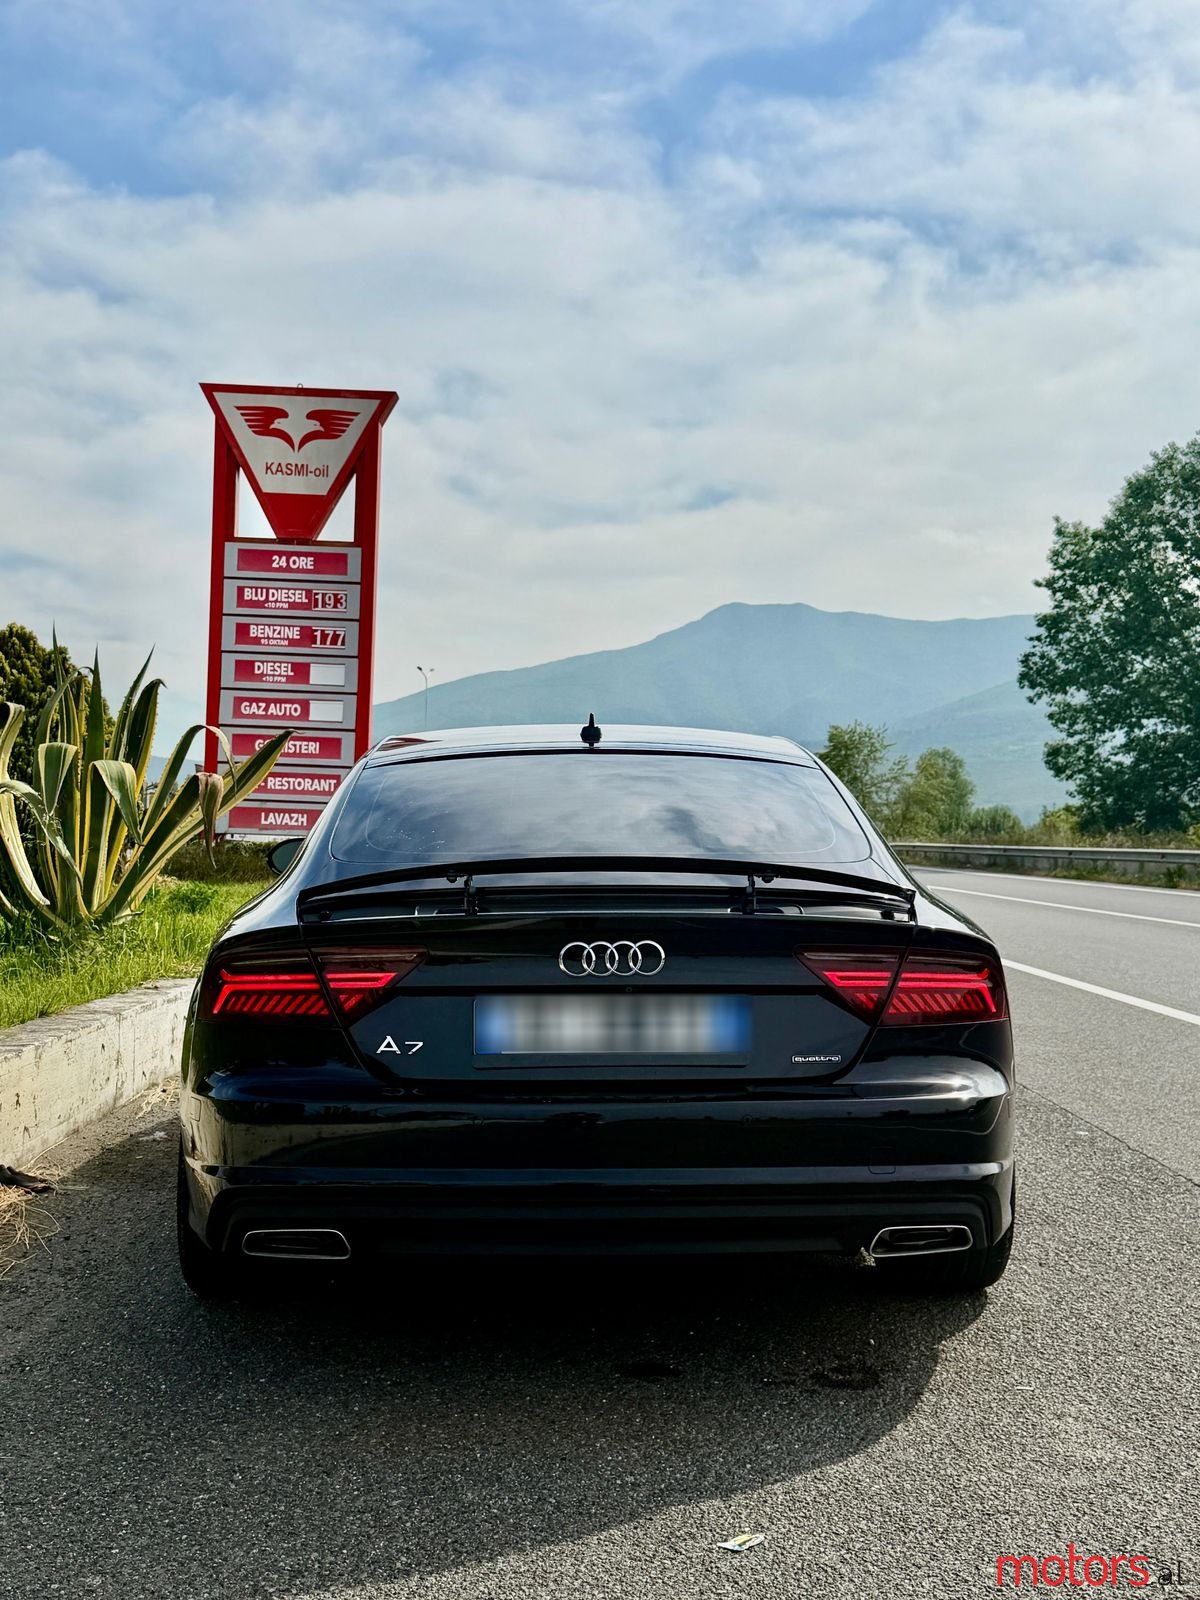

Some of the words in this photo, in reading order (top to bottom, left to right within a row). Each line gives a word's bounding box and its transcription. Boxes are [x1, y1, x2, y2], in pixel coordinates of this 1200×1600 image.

[264, 462, 329, 478] KASMI-oil
[272, 555, 287, 568] 24
[289, 557, 314, 569] ORE
[244, 588, 266, 600] BLU
[268, 589, 308, 602] DIESEL
[315, 593, 347, 609] 193
[249, 625, 300, 639] BENZINE
[313, 629, 345, 647] 177
[254, 662, 294, 676] DIESEL
[240, 702, 266, 715] GAZ
[268, 703, 301, 716] AUTO
[267, 777, 337, 792] RESTORANT
[261, 812, 307, 826] LAVAZH
[376, 1035, 424, 1055] A7
